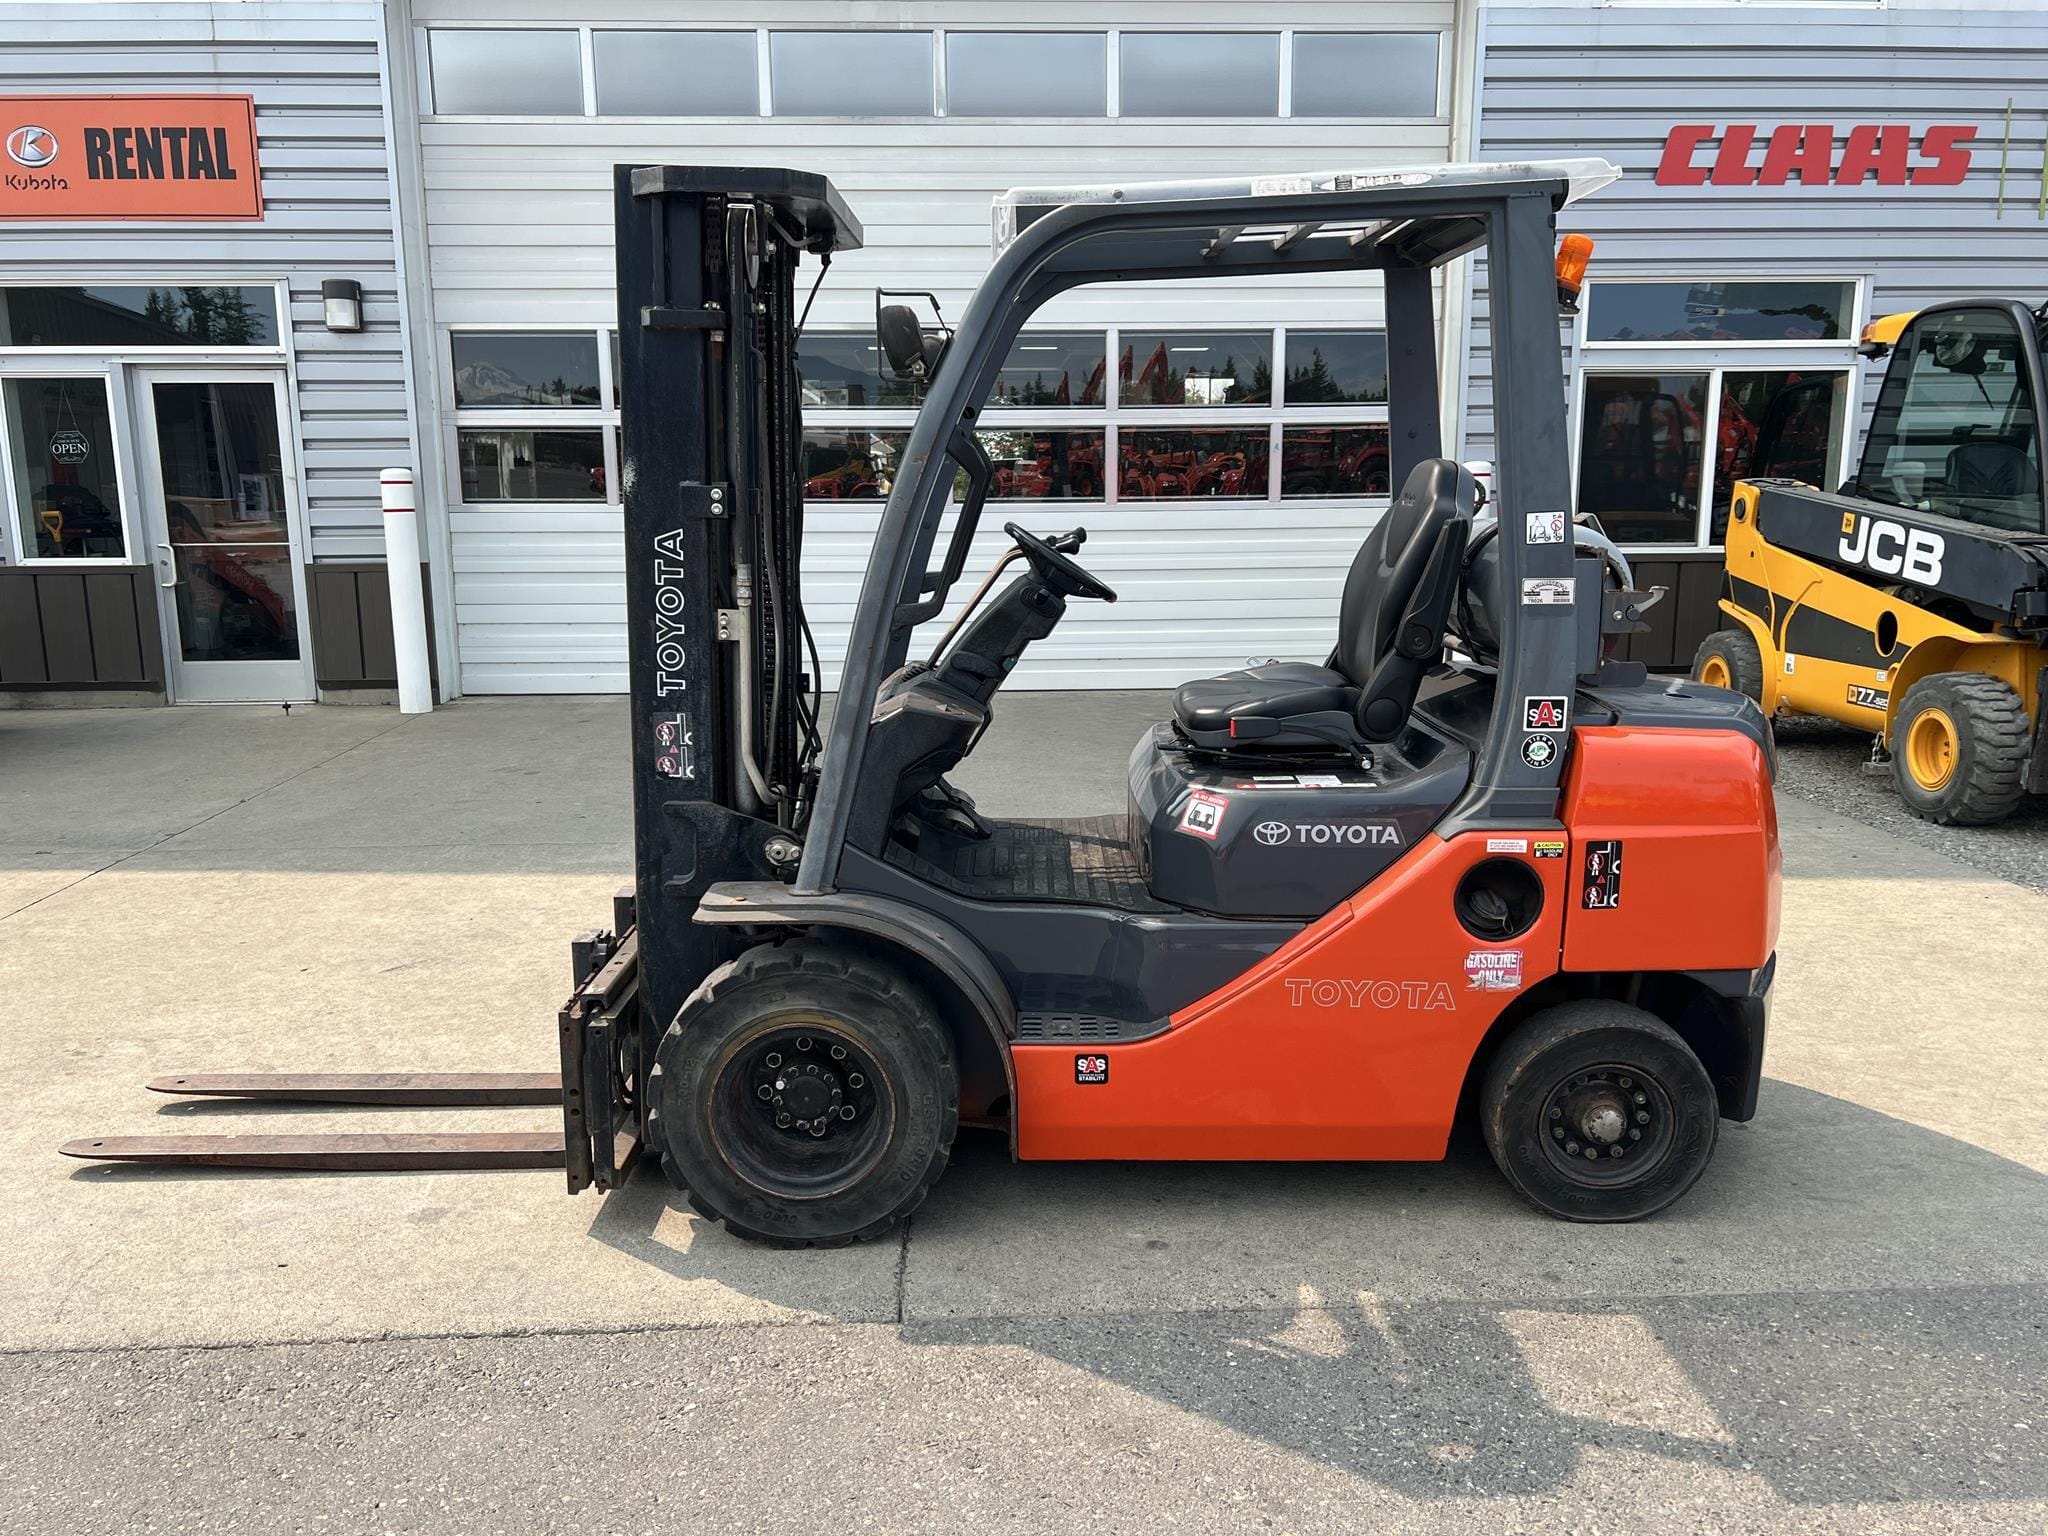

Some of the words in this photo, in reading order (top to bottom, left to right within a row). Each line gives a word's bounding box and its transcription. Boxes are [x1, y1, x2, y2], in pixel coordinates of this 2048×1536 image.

[84, 127, 237, 180] RENTAL
[1655, 125, 1978, 186] CLAAS
[5, 174, 69, 191] Kubota
[52, 443, 87, 455] OPEN
[1838, 516, 1945, 586] JCB
[655, 528, 686, 697] TOYOTA
[1528, 701, 1563, 727] SAS
[1526, 757, 1551, 767] FINAL
[1295, 824, 1400, 845] TOYOTA
[1466, 953, 1518, 969] GASOLINE
[1285, 978, 1456, 1011] TOYOTA
[1077, 1056, 1106, 1073] SAS
